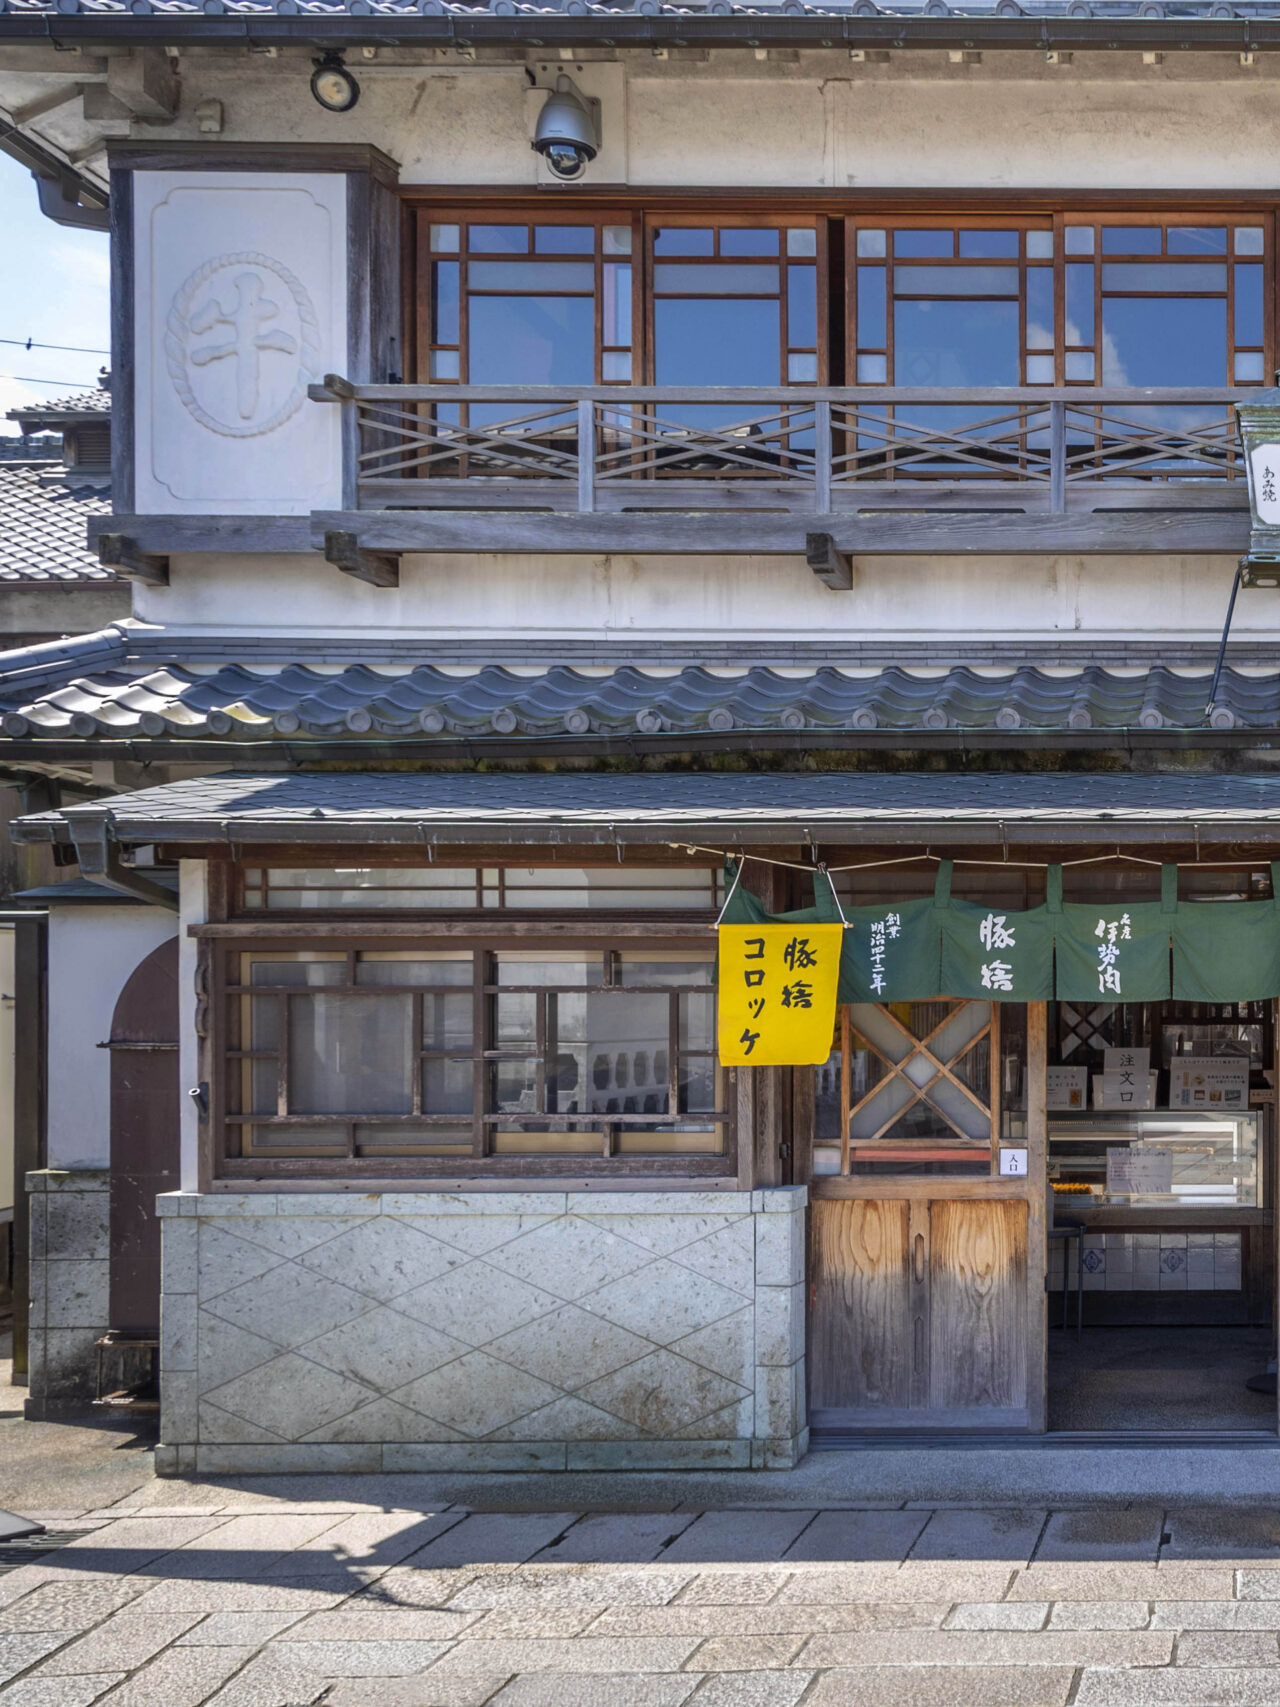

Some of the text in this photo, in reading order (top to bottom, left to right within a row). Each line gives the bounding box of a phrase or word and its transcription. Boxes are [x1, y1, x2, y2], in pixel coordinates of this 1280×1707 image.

[190, 272, 296, 420] 牛
[1262, 465, 1277, 502] あみ焼
[869, 921, 887, 996] 明治四十二年
[885, 912, 902, 939] 創業
[979, 913, 1016, 992] 豚捨
[739, 937, 766, 1056] コロッケ
[781, 936, 818, 1009] 豚捨
[1119, 1054, 1136, 1102] 注文口
[1009, 1154, 1018, 1172] 入口
